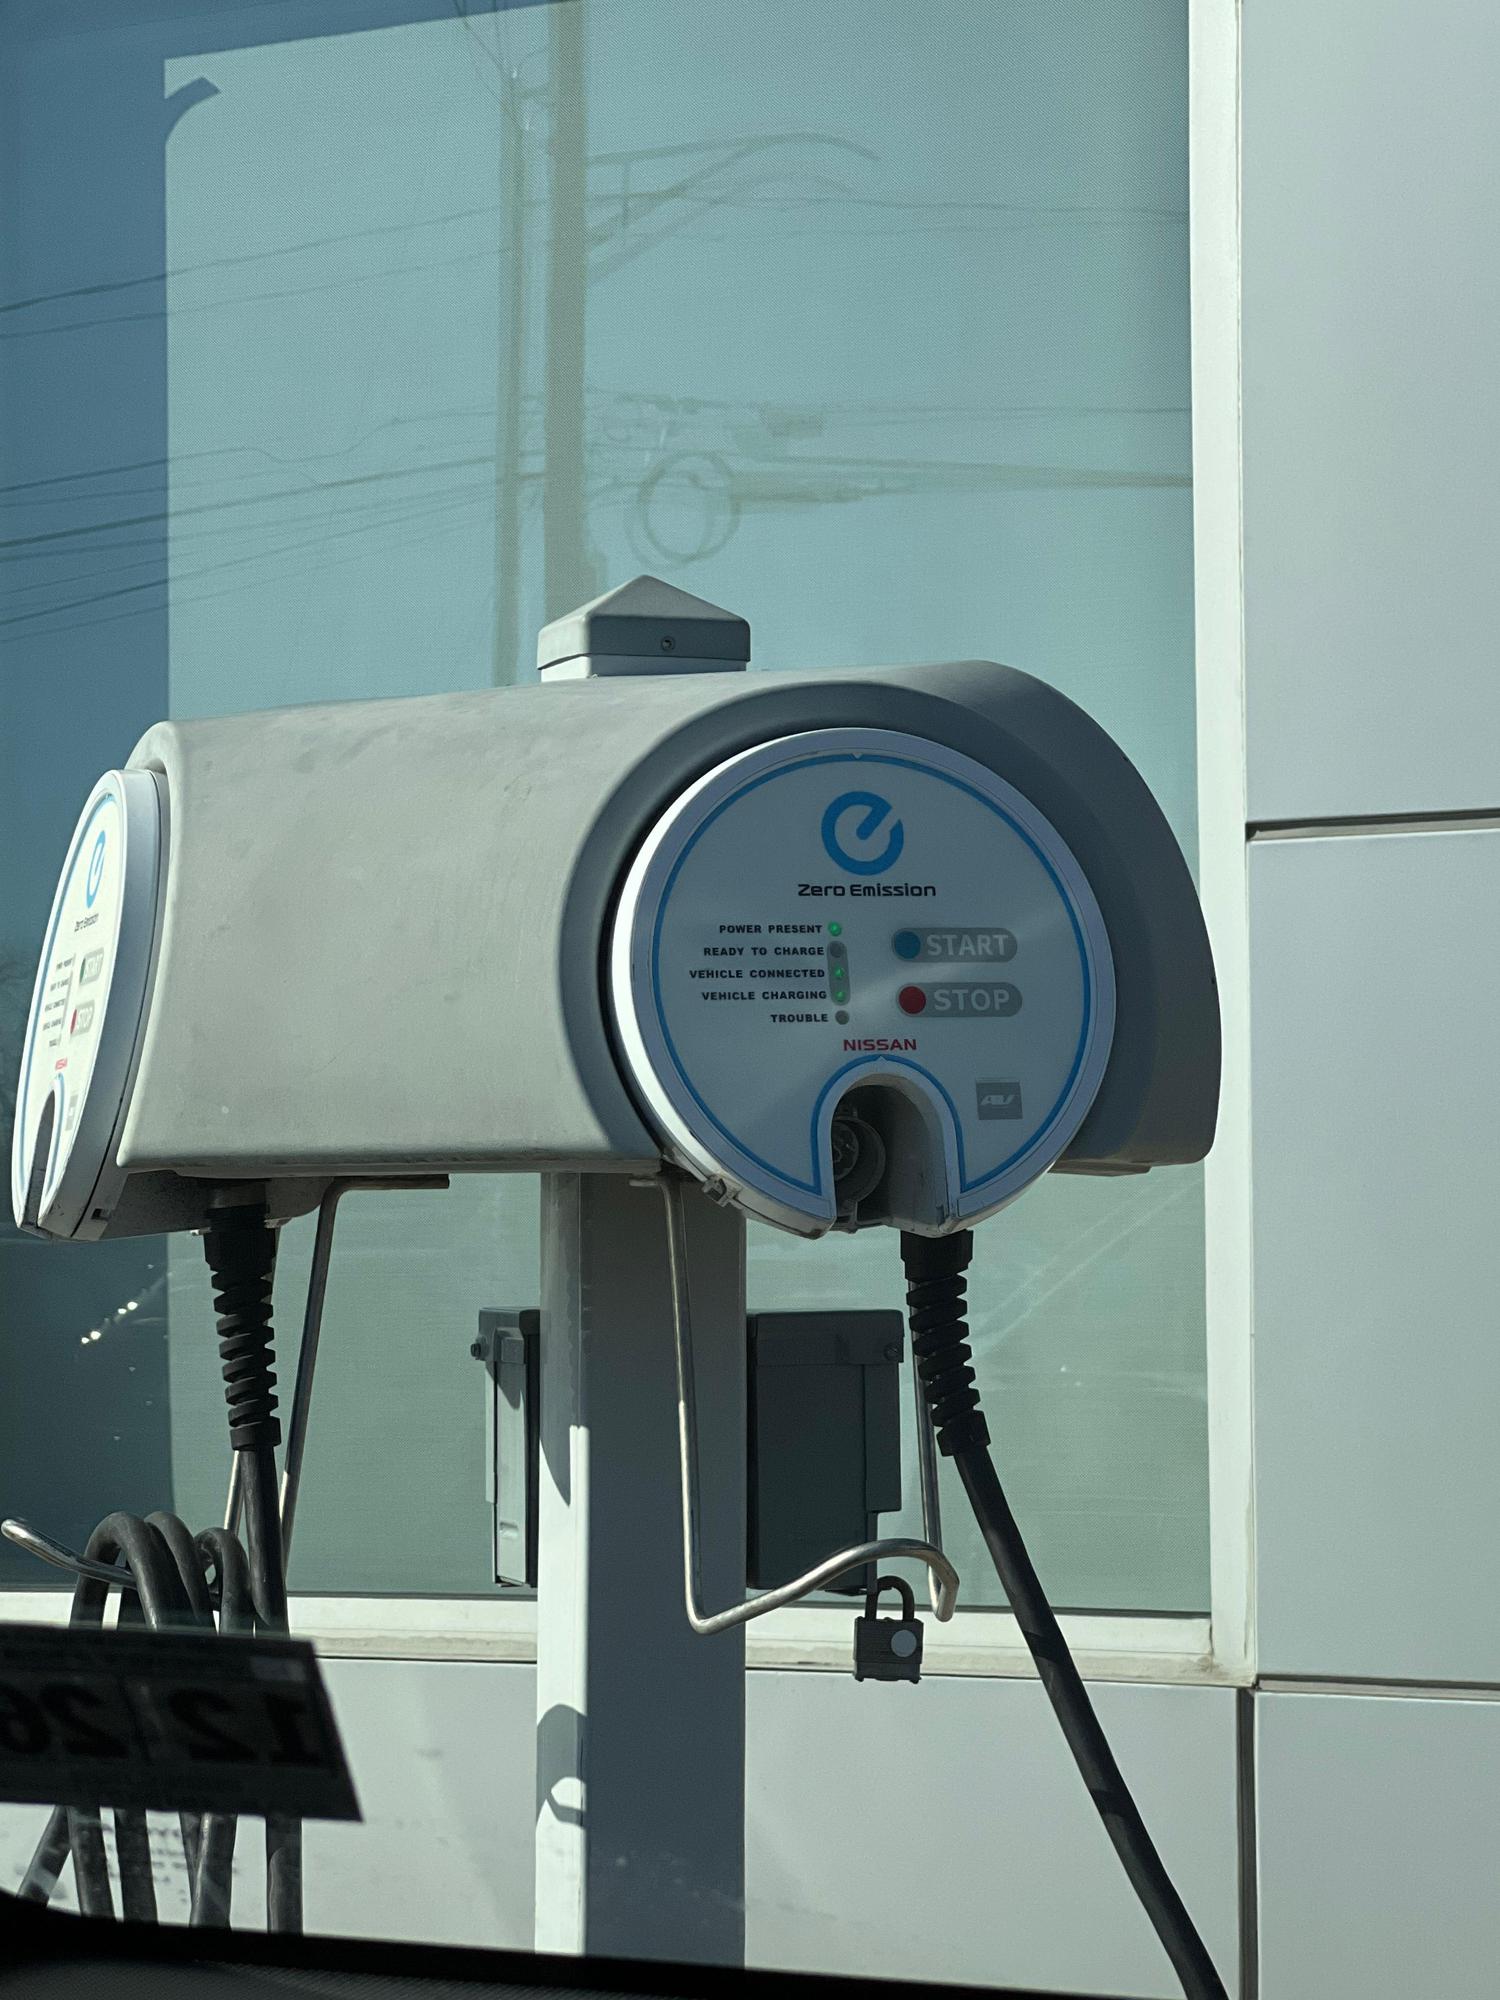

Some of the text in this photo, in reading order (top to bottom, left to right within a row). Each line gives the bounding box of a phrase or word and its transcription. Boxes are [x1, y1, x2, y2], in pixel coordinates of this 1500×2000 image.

[797, 882, 937, 897] Zero Emission
[719, 924, 823, 934] POWER PRESENT
[926, 934, 1009, 956] START
[703, 946, 825, 957] READY TO CHARGE
[689, 969, 826, 979] VEHICLE CONNECTED
[702, 990, 827, 1001] VEHICLE CHARGING
[934, 988, 1010, 1011] STOP
[770, 1013, 829, 1023] TROUBLE
[843, 1038, 918, 1051] NISSAN
